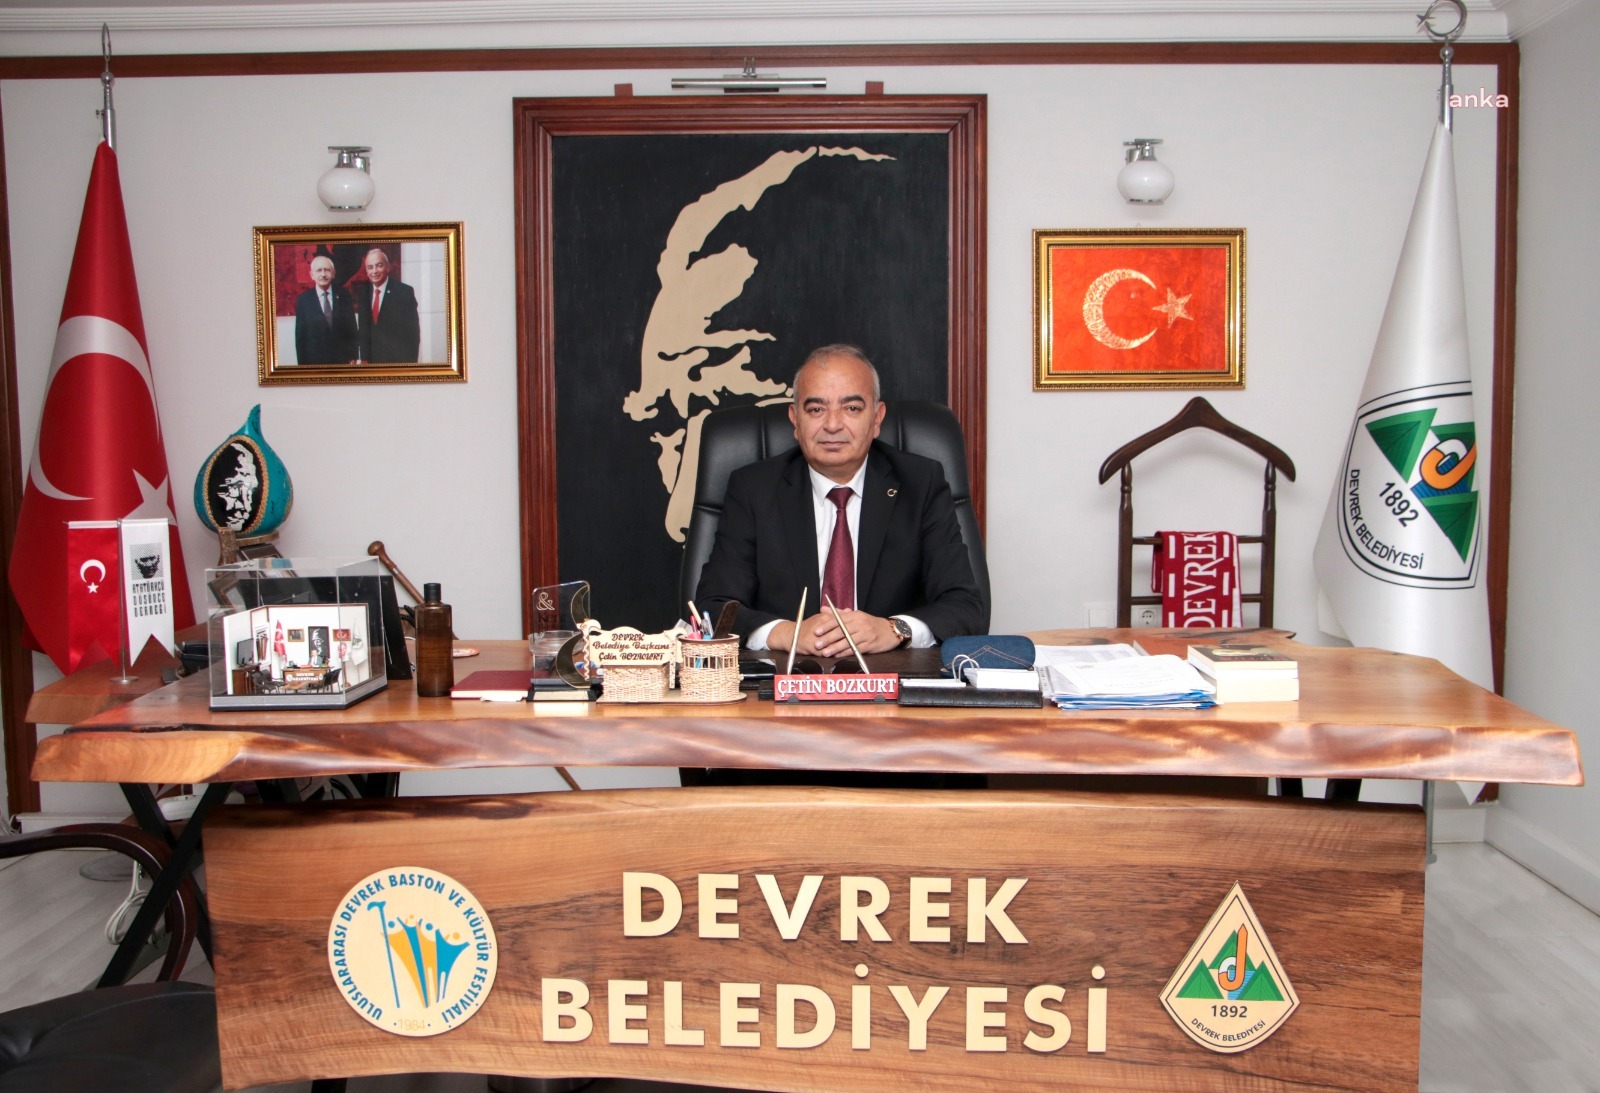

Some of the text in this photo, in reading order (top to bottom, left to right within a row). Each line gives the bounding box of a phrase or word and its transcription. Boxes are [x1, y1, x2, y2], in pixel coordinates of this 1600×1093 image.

[1379, 481, 1419, 527] 1892
[1349, 469, 1424, 570] DEVREK BELEDİYESİ
[592, 640, 630, 652] Belediye
[611, 633, 645, 641] DEVREK
[598, 652, 617, 662] Çetin
[777, 676, 897, 698] ÇETİN BOZKURT
[622, 871, 1029, 944] DEVREK
[333, 873, 492, 1028] ULUSLARARASI DEVREK BASTON VE KÜLTÜR FESTİVALİ
[541, 963, 1108, 1053] BELEDİYESİ
[1211, 1005, 1248, 1018] 1892
[398, 1018, 426, 1031] 1984
[1191, 1018, 1266, 1042] DEVREK BELEDİYESİ
